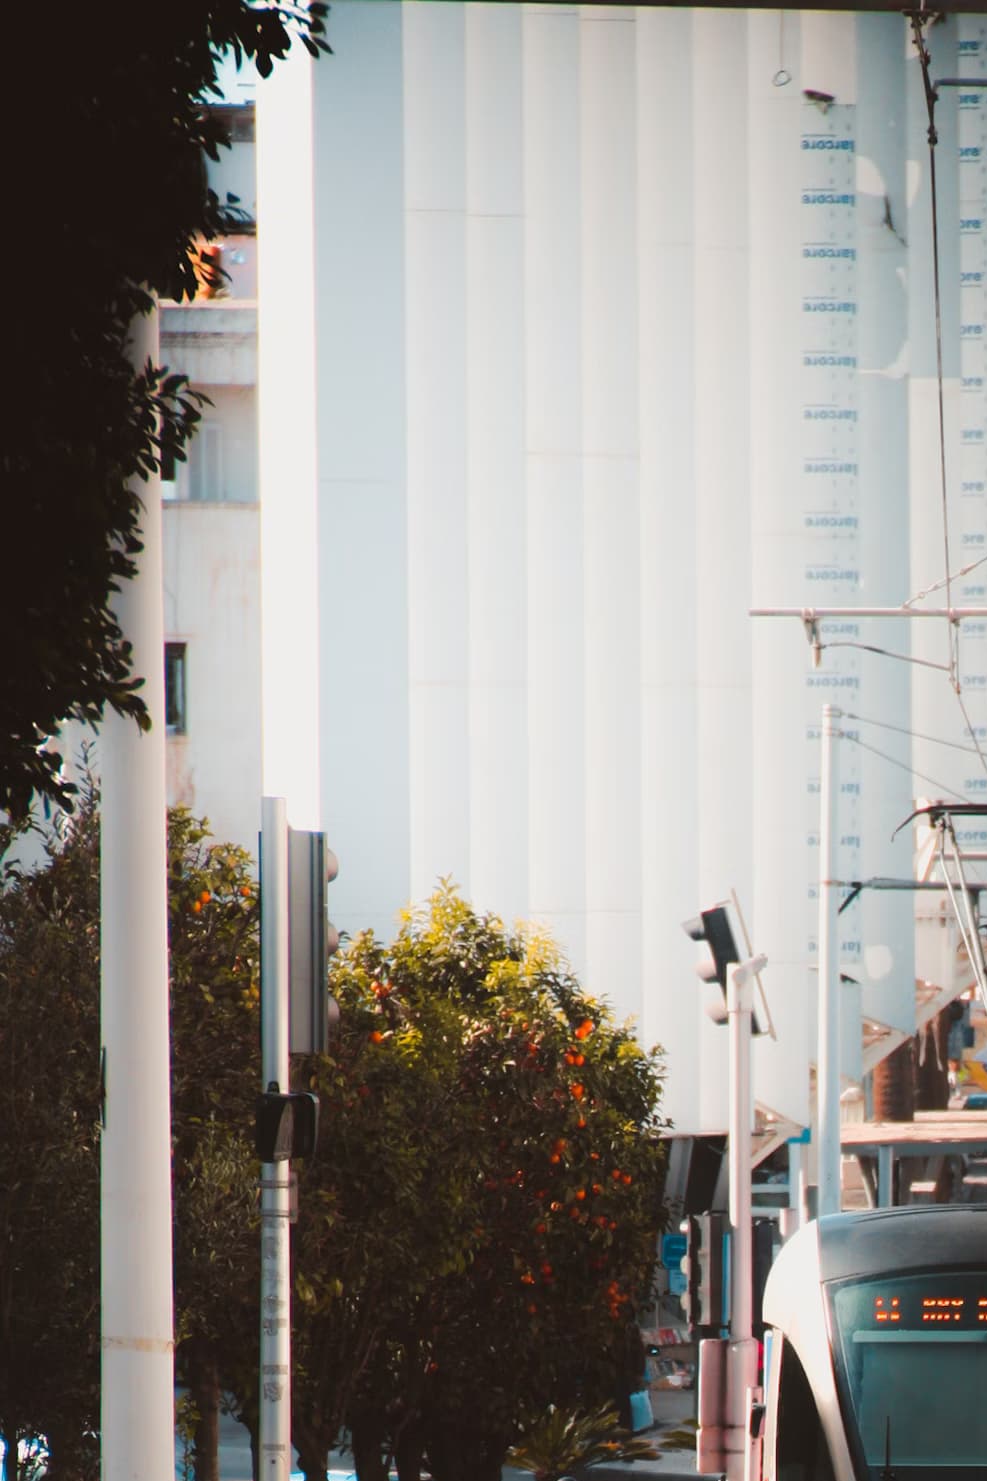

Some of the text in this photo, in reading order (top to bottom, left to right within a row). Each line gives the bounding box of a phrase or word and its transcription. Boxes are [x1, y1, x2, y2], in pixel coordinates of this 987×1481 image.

[801, 140, 855, 152] larcore
[802, 195, 855, 207] larcore
[803, 249, 856, 260] larcore
[803, 302, 856, 314] larcore
[804, 356, 856, 368] larcore
[804, 410, 857, 422] larcore
[805, 517, 859, 529] larcore
[821, 624, 859, 636] larco
